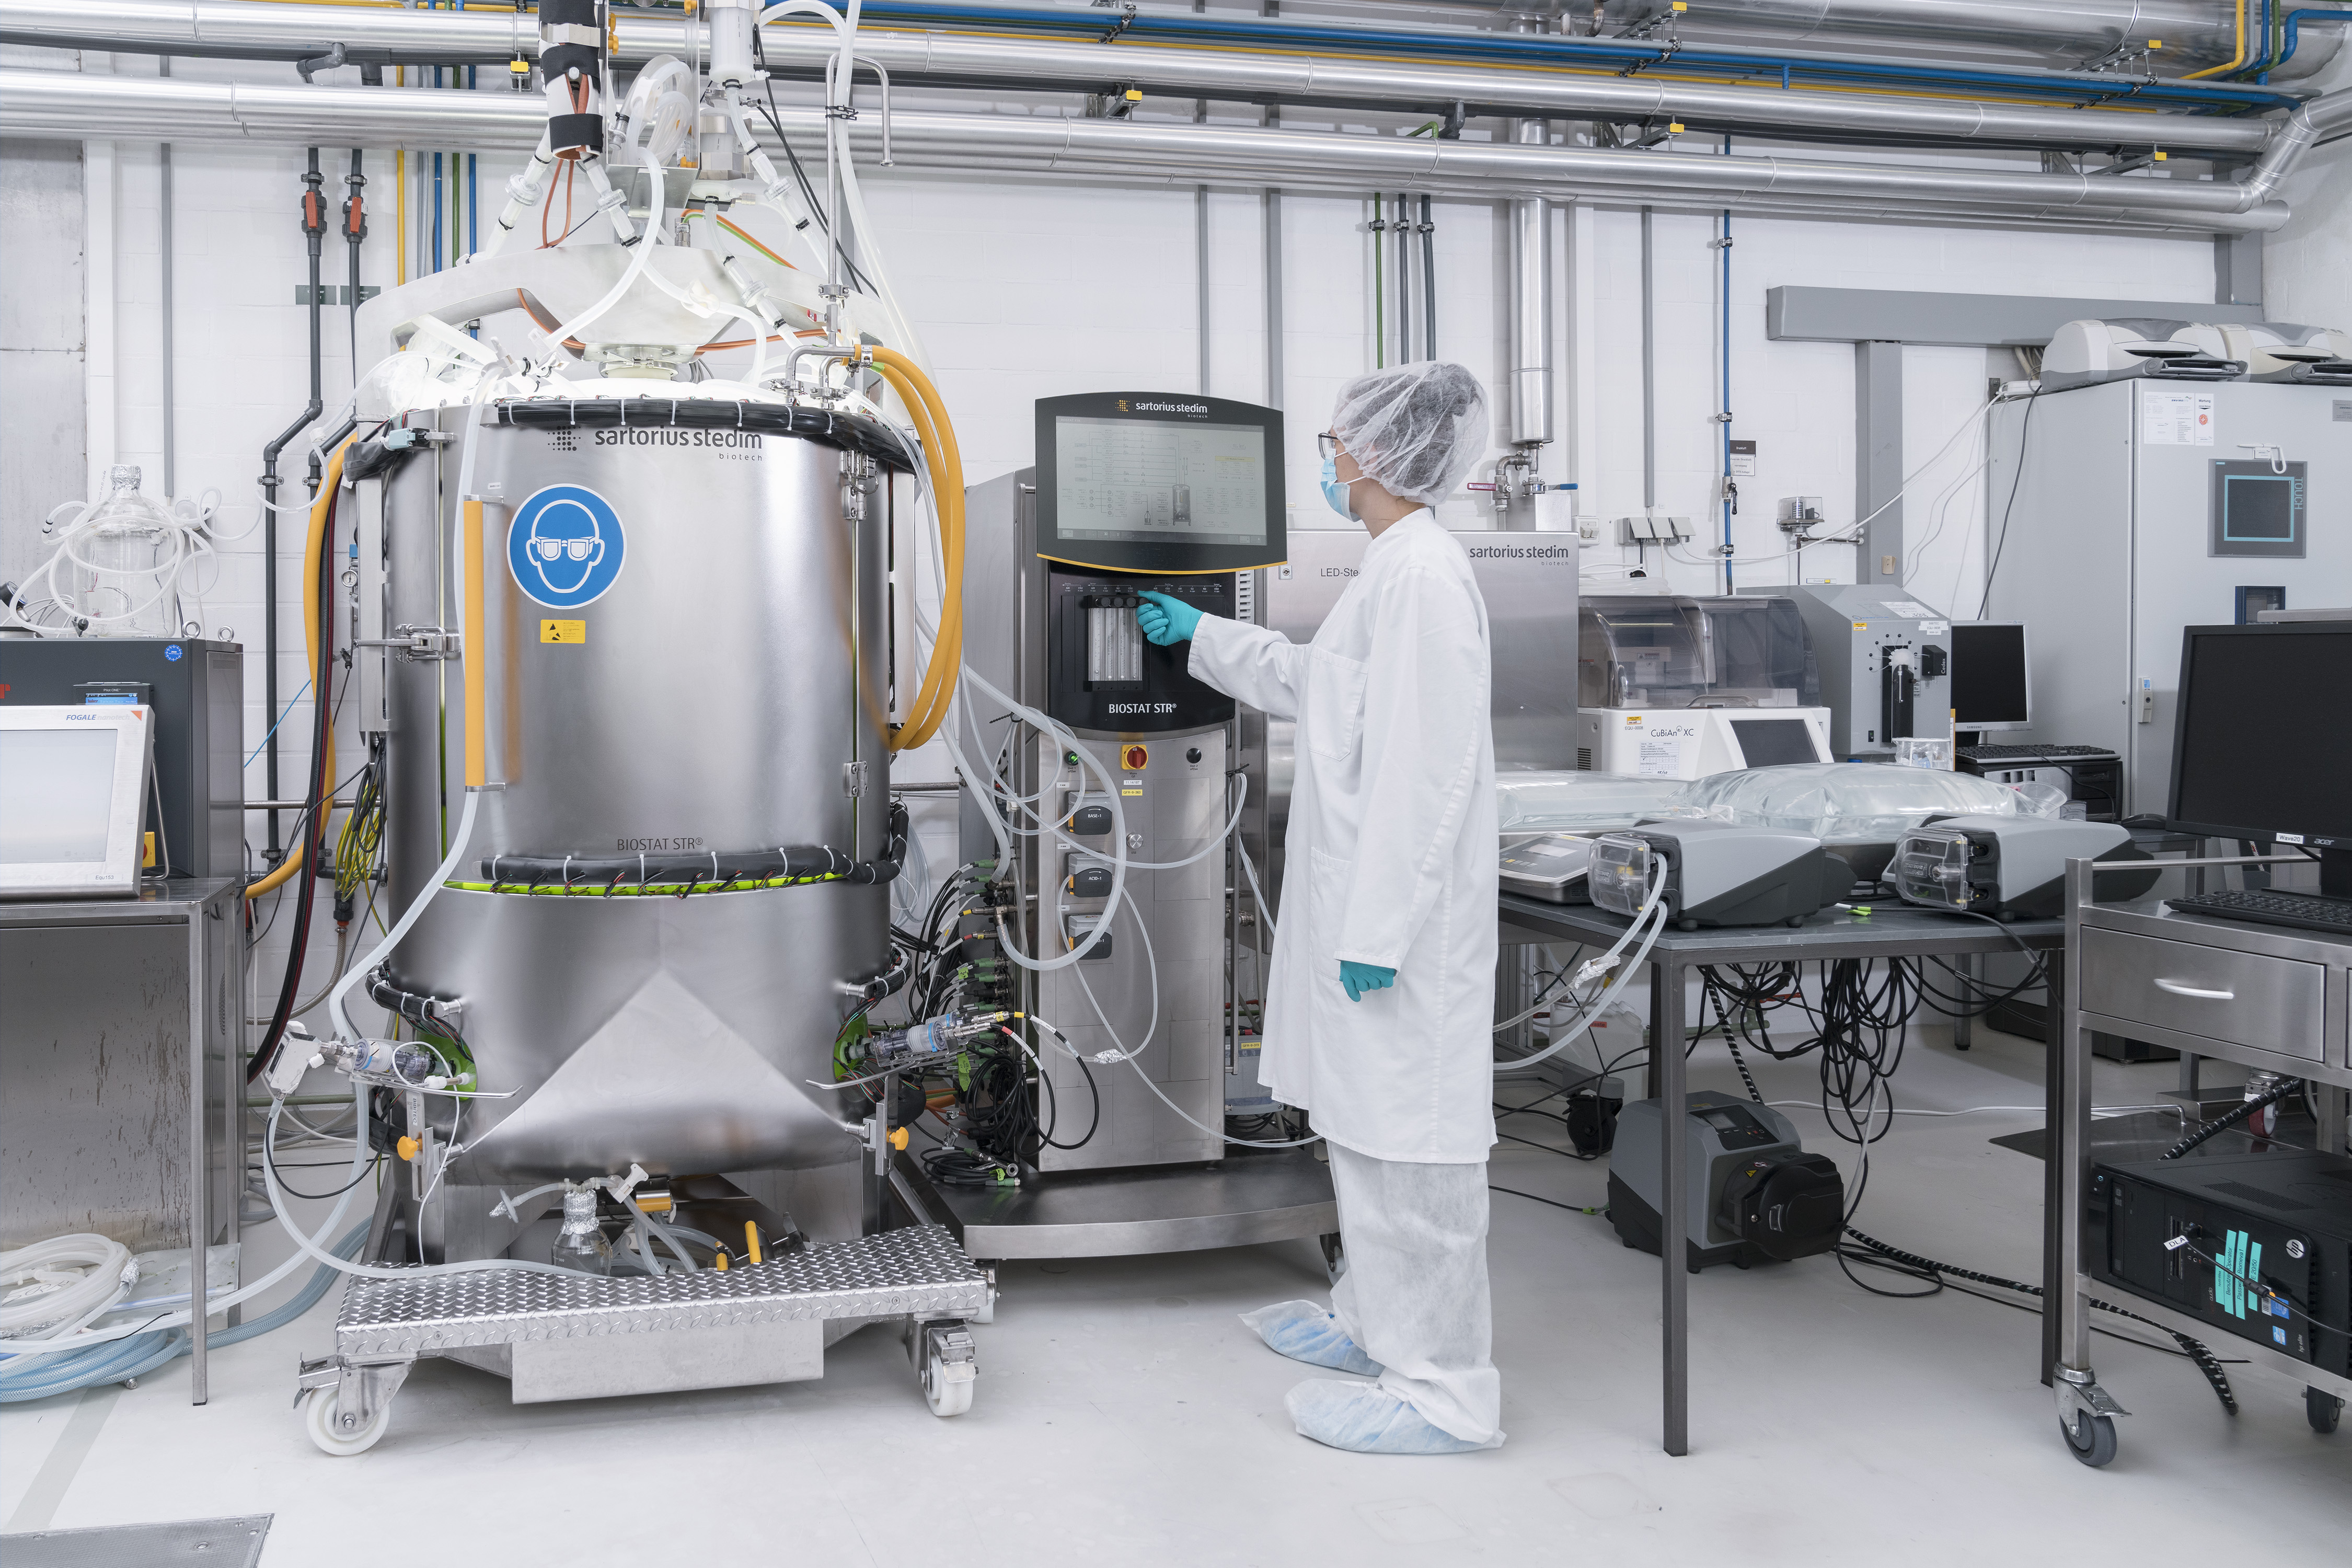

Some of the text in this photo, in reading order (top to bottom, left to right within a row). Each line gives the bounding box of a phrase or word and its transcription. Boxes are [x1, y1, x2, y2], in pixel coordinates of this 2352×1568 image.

[1136, 401, 1207, 413] sartorius stedim
[595, 425, 762, 449] sartorius stedim
[719, 453, 763, 462] biotech
[2294, 477, 2303, 510] TOUCH
[1469, 545, 1569, 558] sartorius stedim
[1320, 568, 1360, 578] LED-Ste
[1109, 704, 1151, 713] BIOSTAT
[1683, 728, 1694, 736] XC
[617, 838, 670, 851] BIOSTAT
[2169, 1237, 2185, 1248] DLA
[2287, 1240, 2302, 1257] hp
